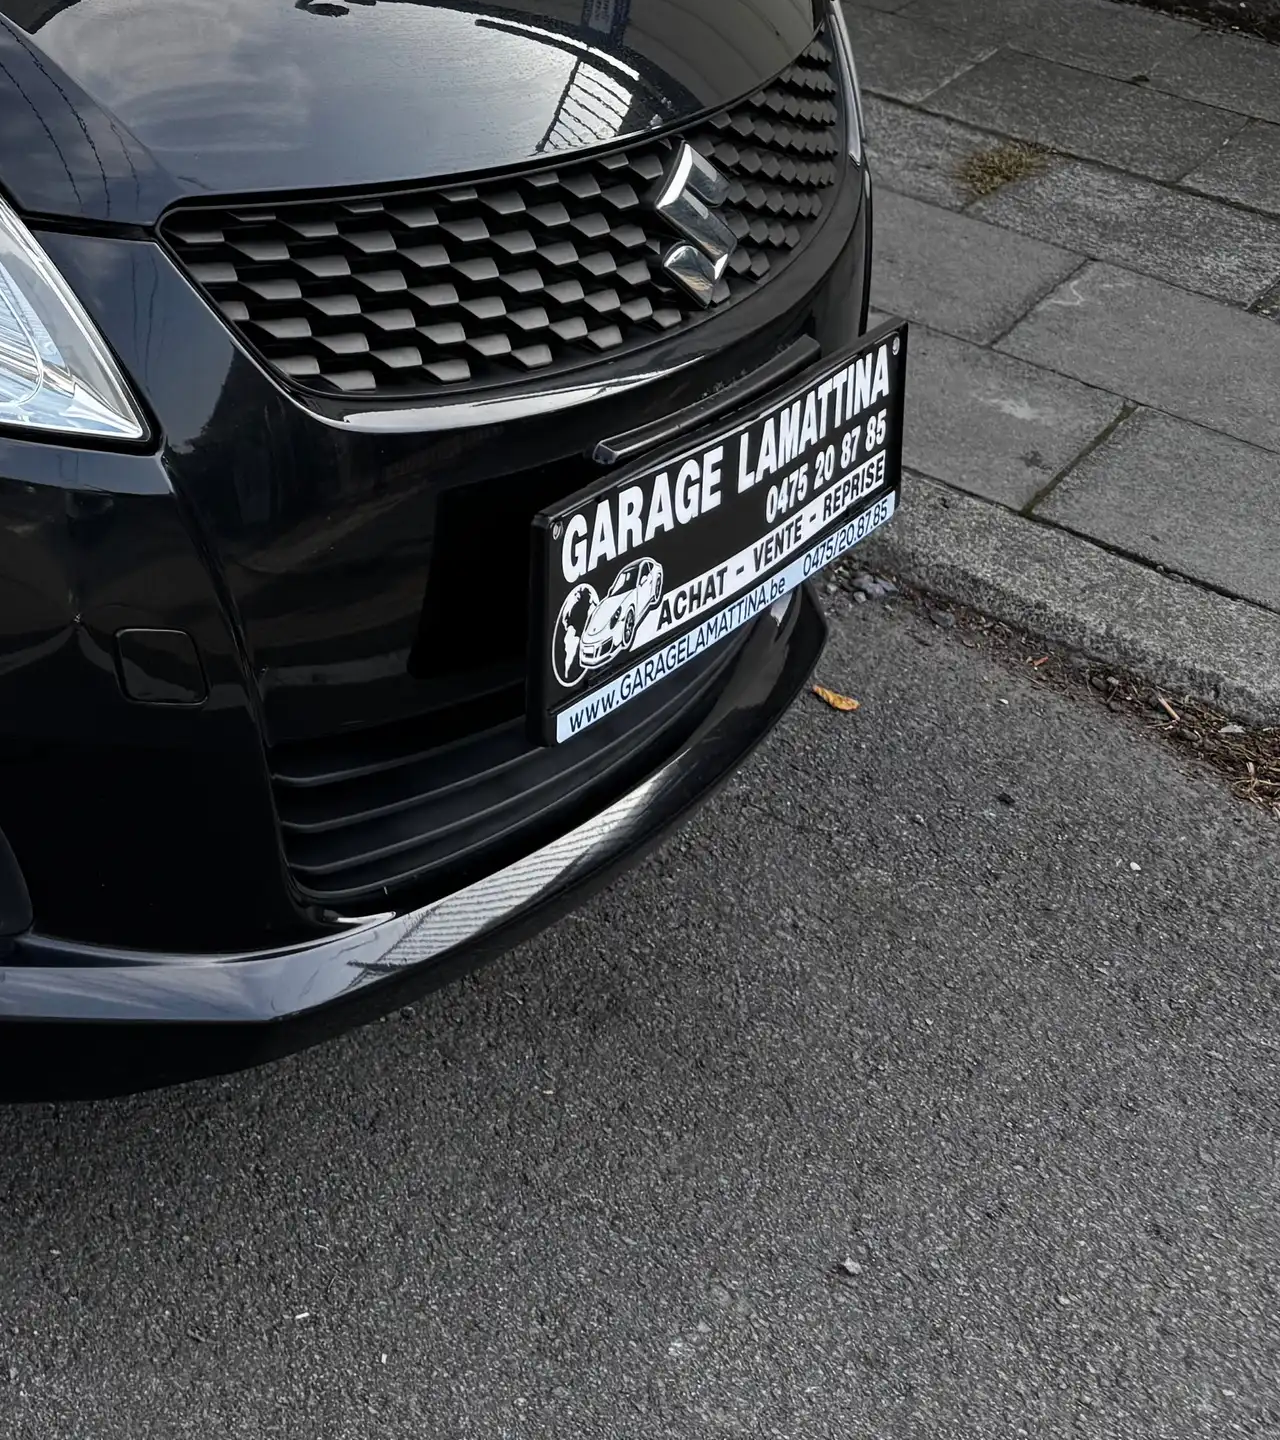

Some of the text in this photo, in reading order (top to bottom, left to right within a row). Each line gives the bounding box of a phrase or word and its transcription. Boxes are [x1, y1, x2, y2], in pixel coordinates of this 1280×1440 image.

[561, 343, 890, 584] GARAGE LAMATTINA
[656, 569, 729, 632] ACHAT
[753, 521, 804, 574] VENTE
[822, 458, 885, 523] REPRISE
[765, 408, 888, 525] 0475 20 87 85
[568, 500, 889, 733] www.GARAGELAMATTINA.be 0475/20.87.85
